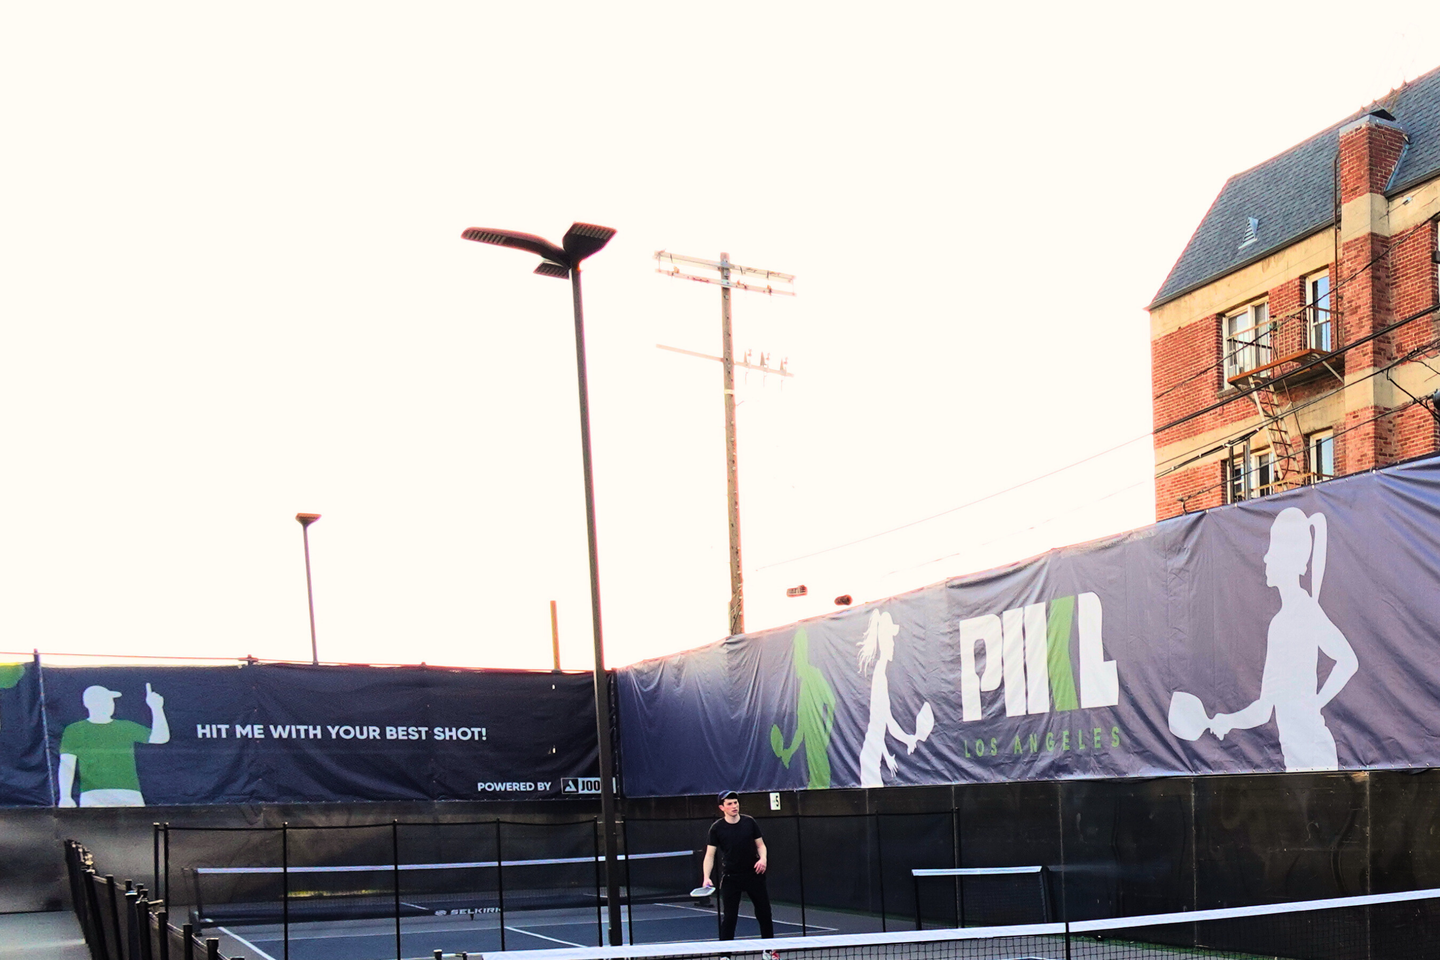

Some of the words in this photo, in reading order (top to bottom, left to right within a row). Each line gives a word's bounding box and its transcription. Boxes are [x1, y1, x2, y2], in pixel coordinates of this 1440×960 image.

[197, 725, 229, 738] HIT
[235, 725, 264, 738] ME
[270, 725, 321, 738] WITH
[327, 726, 380, 739] YOUR
[386, 727, 428, 739] BEST
[434, 727, 486, 740] SHOT!
[964, 739, 998, 758] LOS
[1014, 726, 1121, 755] ANGELES
[478, 782, 534, 791] POWERED
[537, 782, 551, 790] BY
